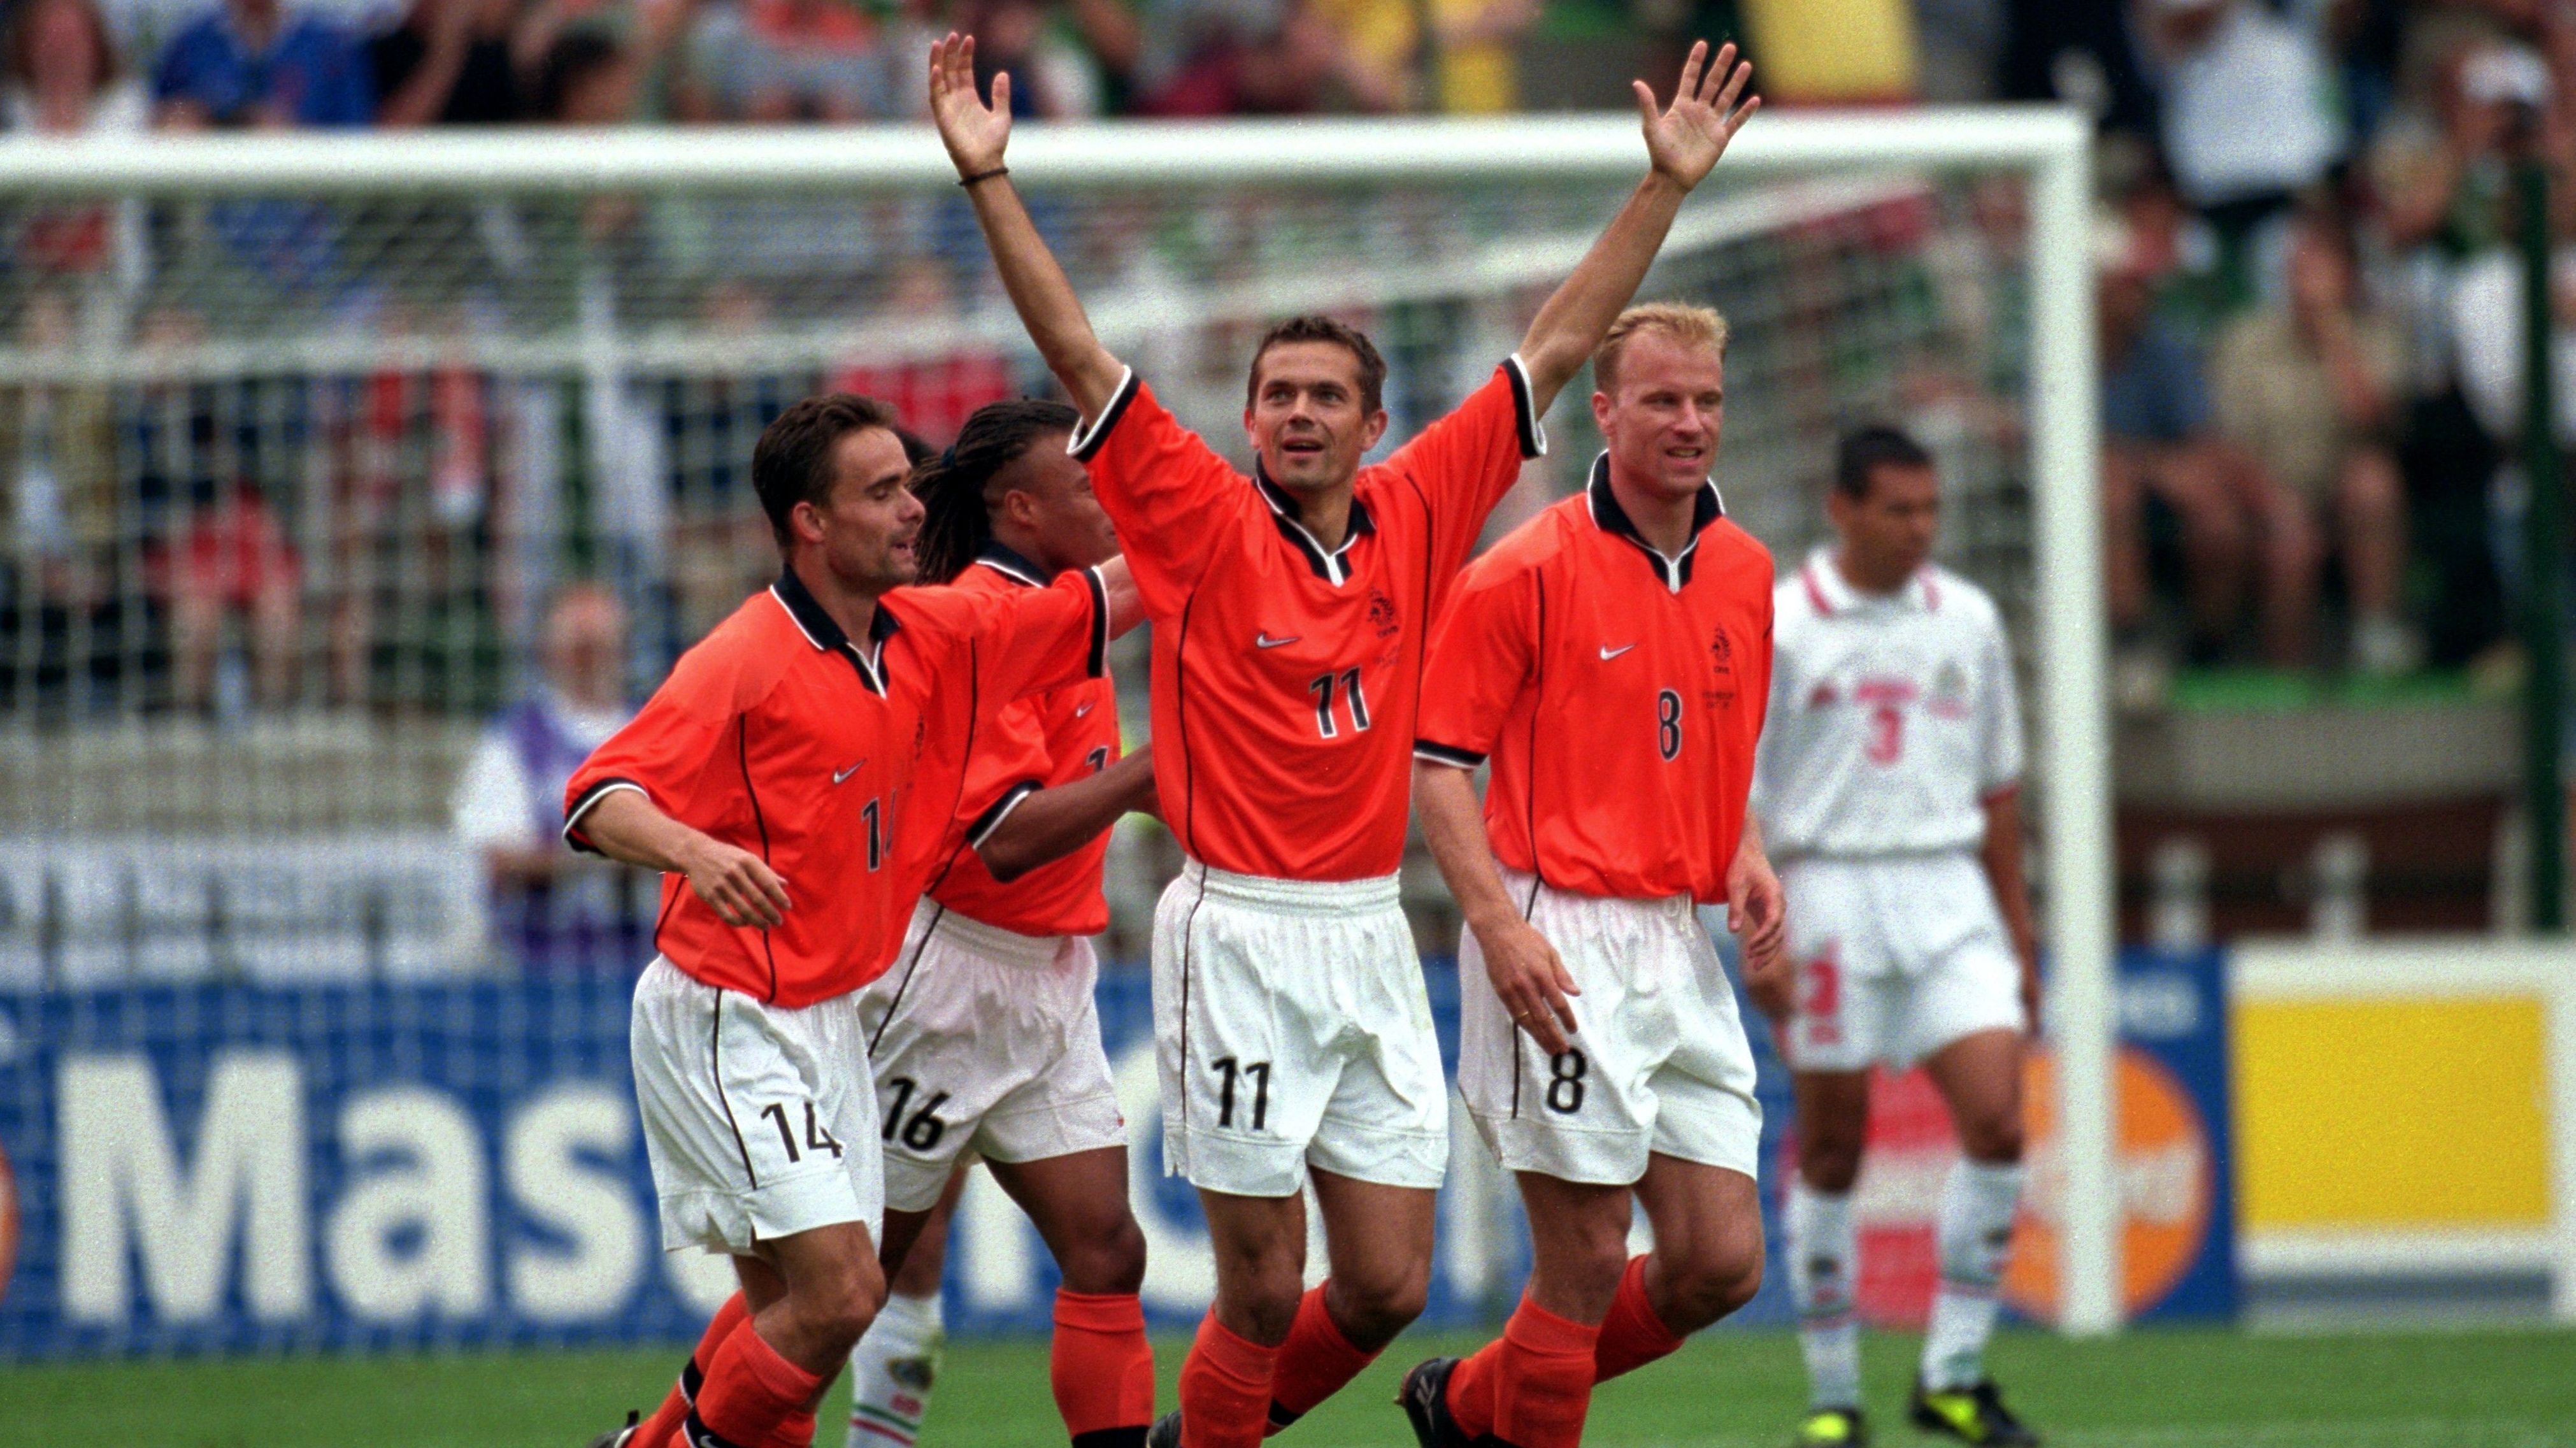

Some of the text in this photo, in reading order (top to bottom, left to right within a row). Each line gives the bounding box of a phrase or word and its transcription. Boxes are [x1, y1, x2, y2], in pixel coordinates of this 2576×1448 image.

[1309, 665, 1370, 738] 11
[1659, 688, 1682, 761] 8
[861, 787, 896, 873] 1
[882, 1077, 951, 1152] 16
[1212, 1056, 1270, 1130] 11
[1547, 1049, 1587, 1114] 8
[761, 1103, 843, 1163] 14
